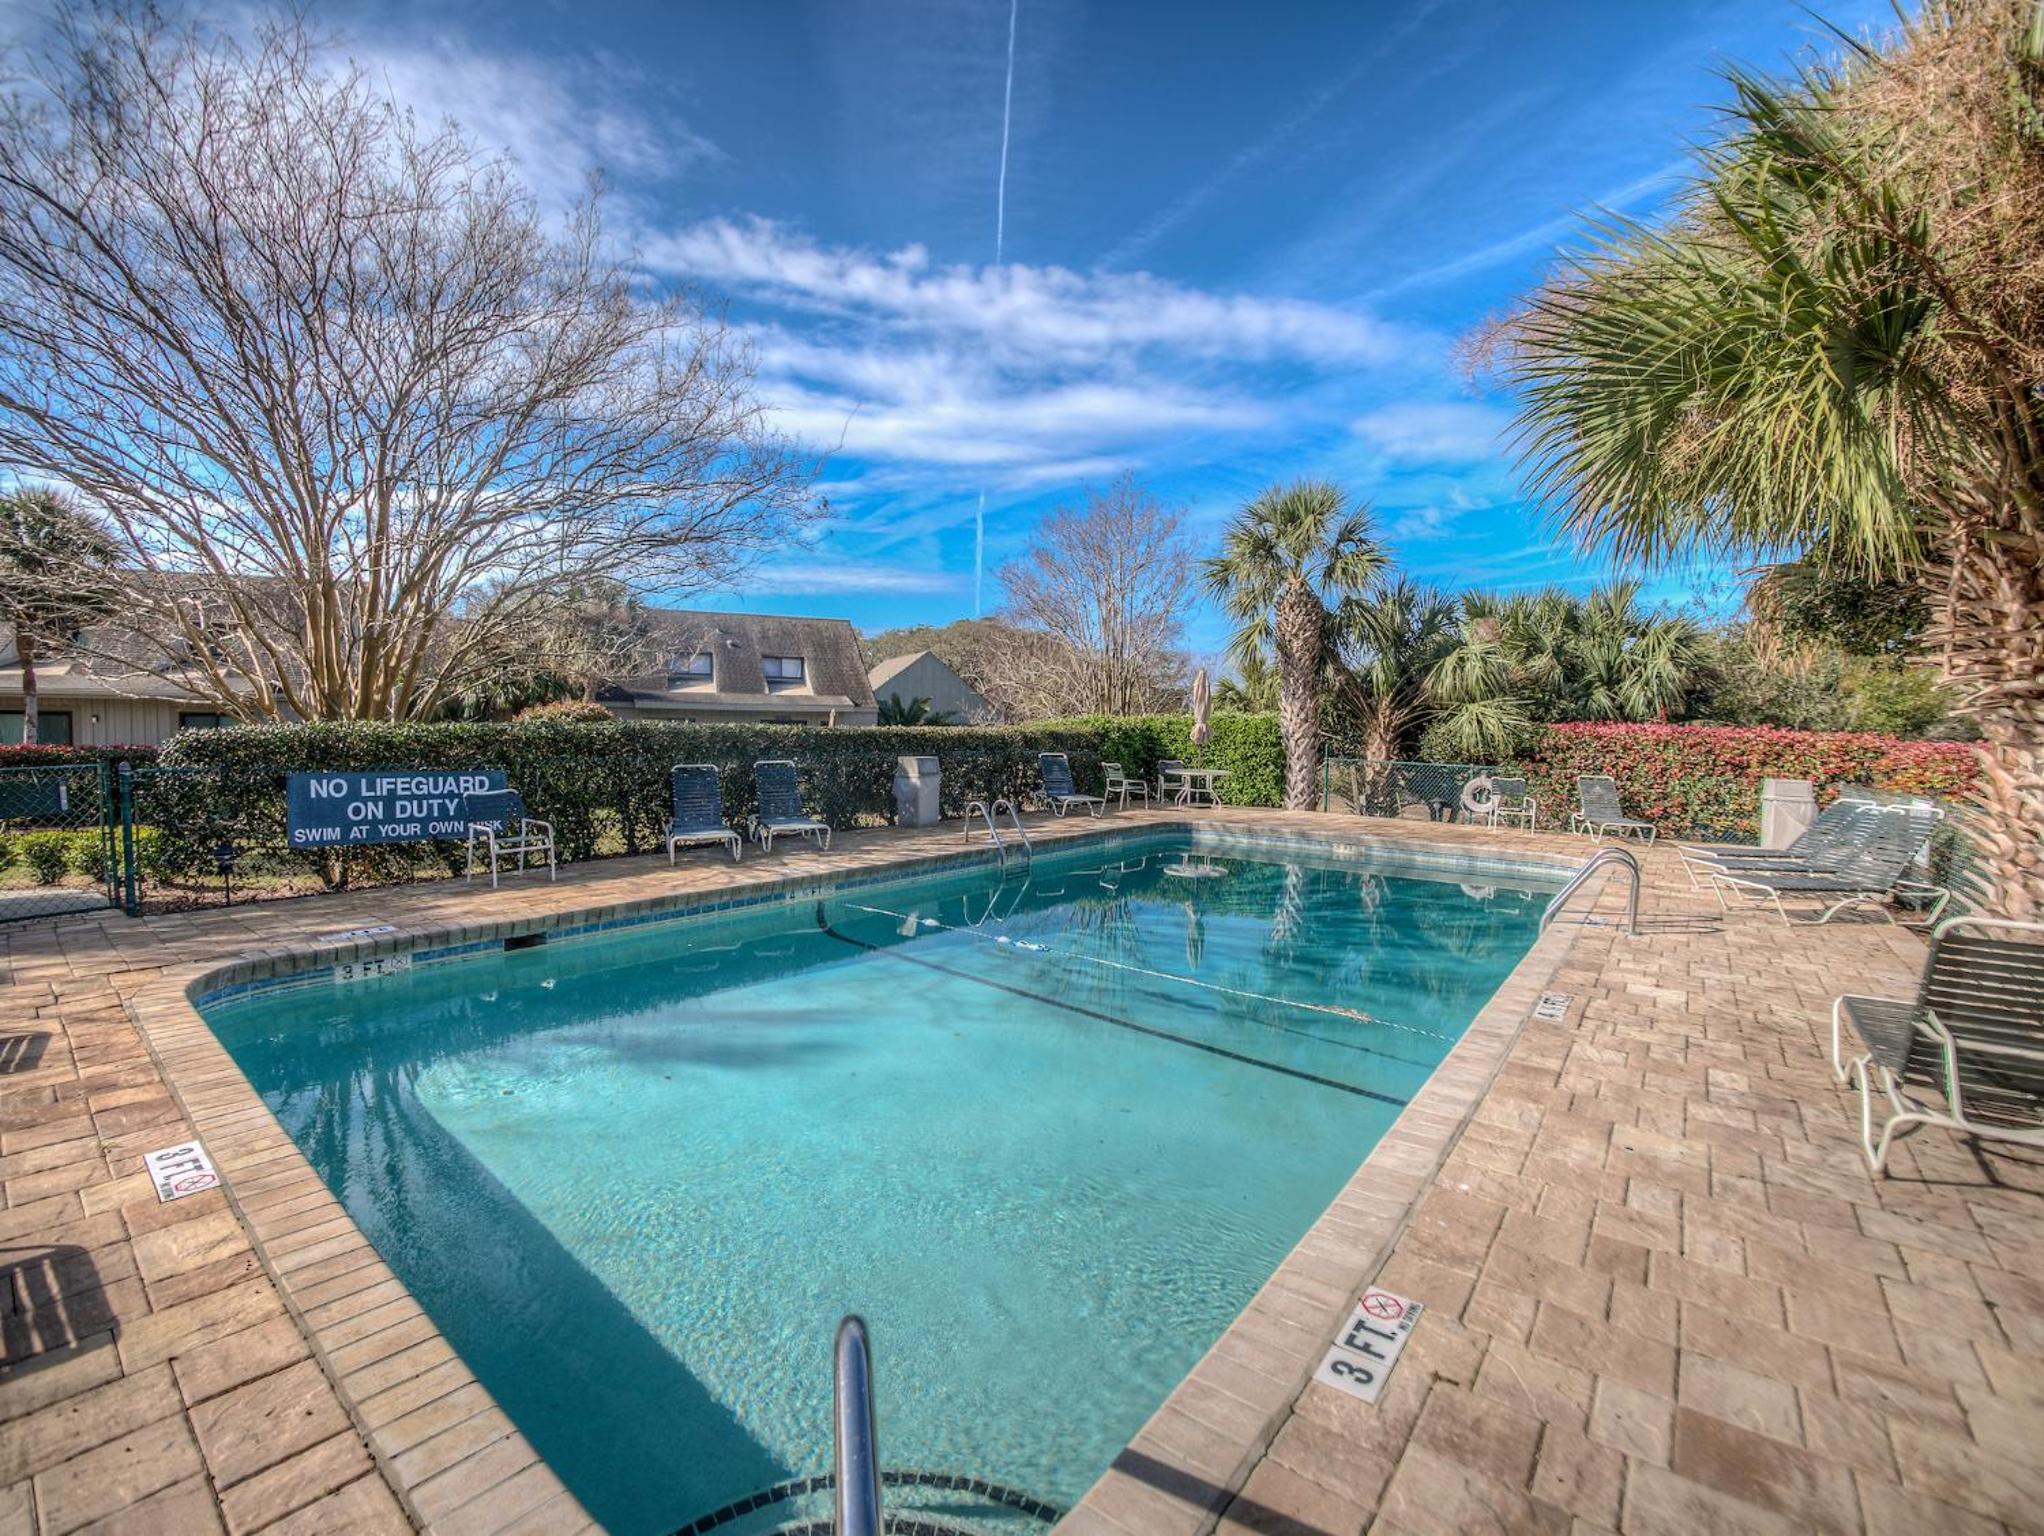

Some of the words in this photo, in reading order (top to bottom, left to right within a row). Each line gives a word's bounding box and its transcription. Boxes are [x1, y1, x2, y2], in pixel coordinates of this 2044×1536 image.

[310, 778, 348, 799] NO
[361, 776, 489, 797] LIFEGUARD
[347, 801, 384, 821] ON
[395, 799, 459, 819] DUTY
[294, 827, 341, 843] SWIM
[349, 825, 370, 840] AT
[378, 823, 421, 837] YOUR
[428, 820, 464, 835] OWN
[156, 1148, 194, 1162] 3
[1344, 1318, 1398, 1360] FT.
[1330, 1360, 1374, 1384] 3
